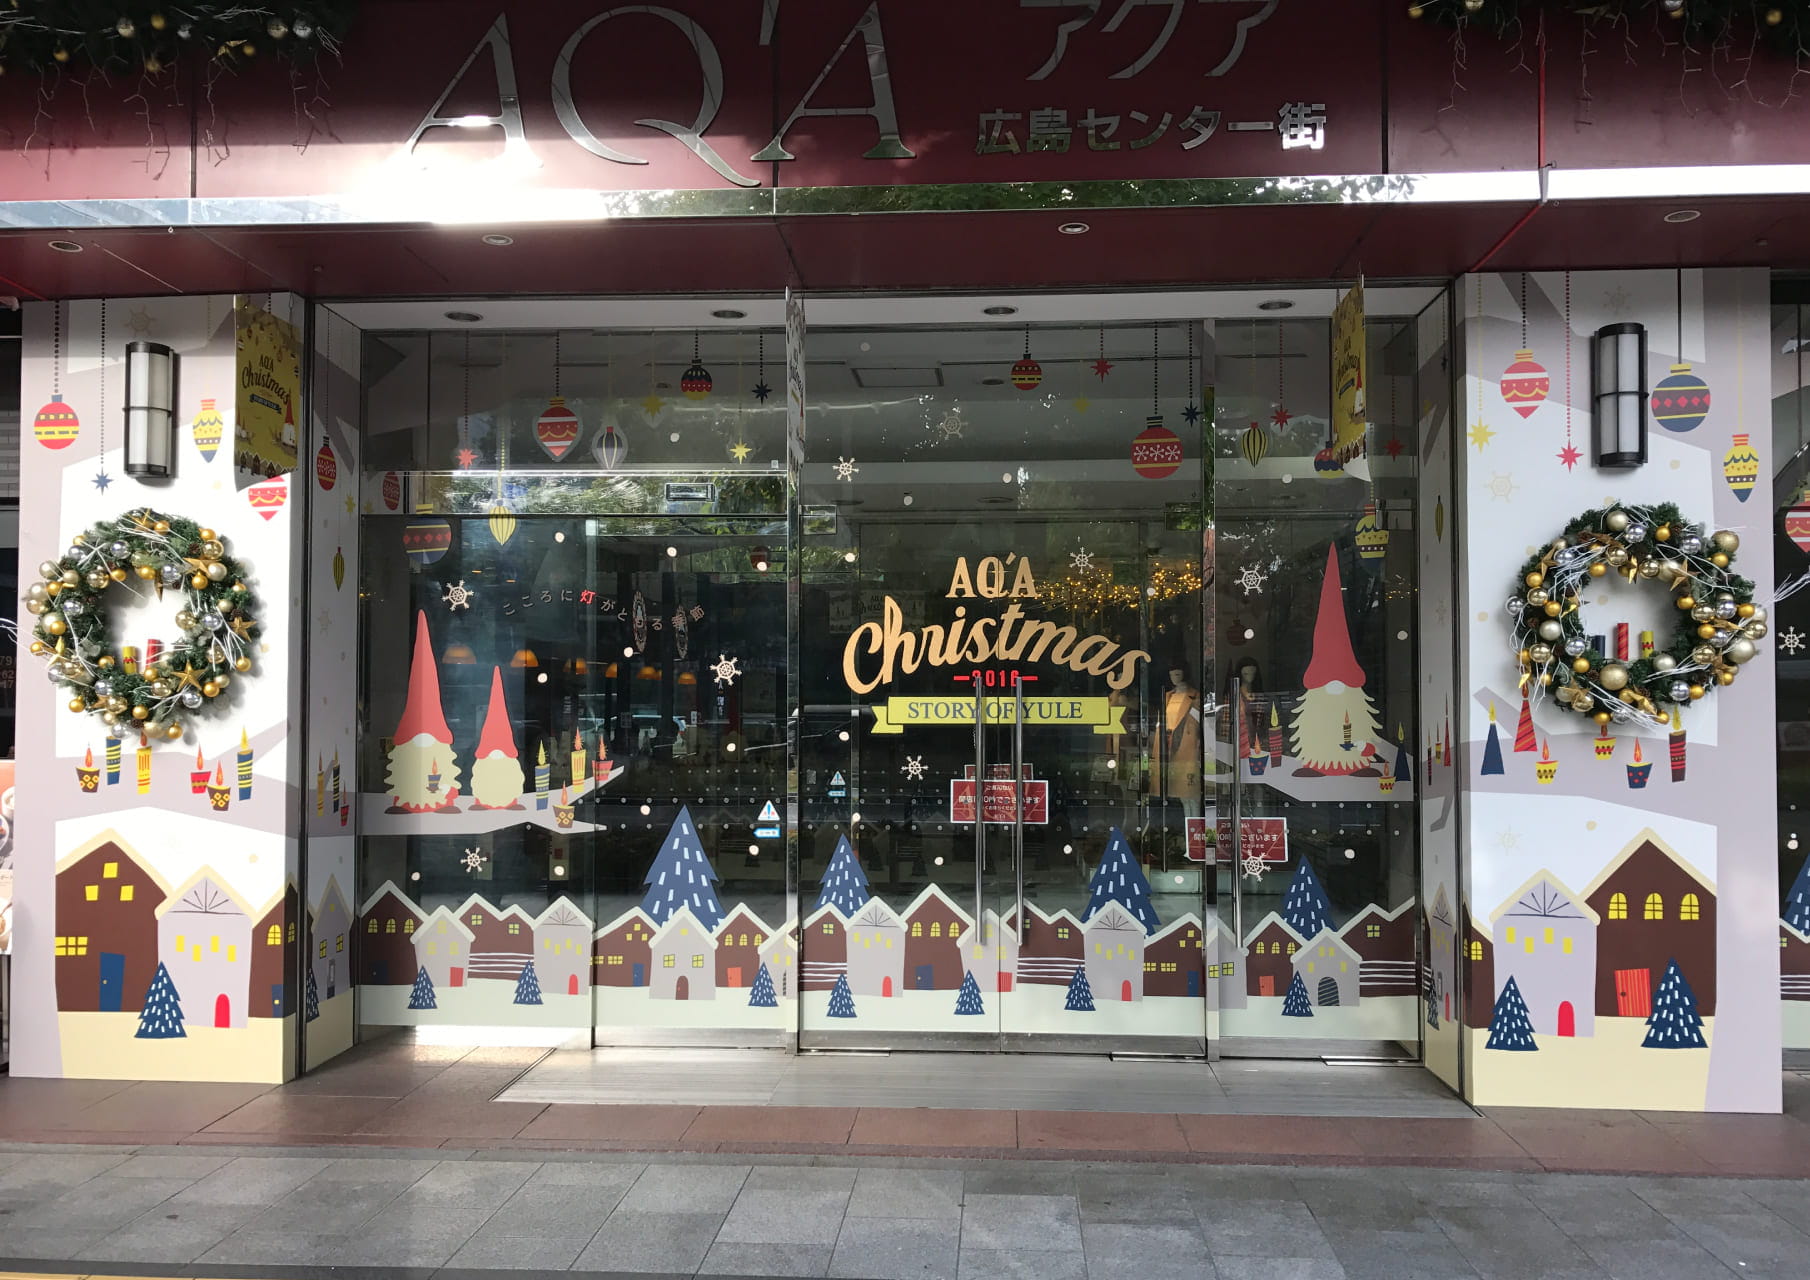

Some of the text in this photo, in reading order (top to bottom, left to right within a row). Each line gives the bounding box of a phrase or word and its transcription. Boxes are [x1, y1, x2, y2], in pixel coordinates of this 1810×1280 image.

[1019, 0, 1278, 81] アクア
[975, 101, 1327, 155] 広島センター街
[242, 360, 290, 405] Christmas
[945, 552, 1038, 599] AQ'A
[842, 595, 1151, 694] Christmas
[908, 702, 1083, 719] STORY OF YULE
